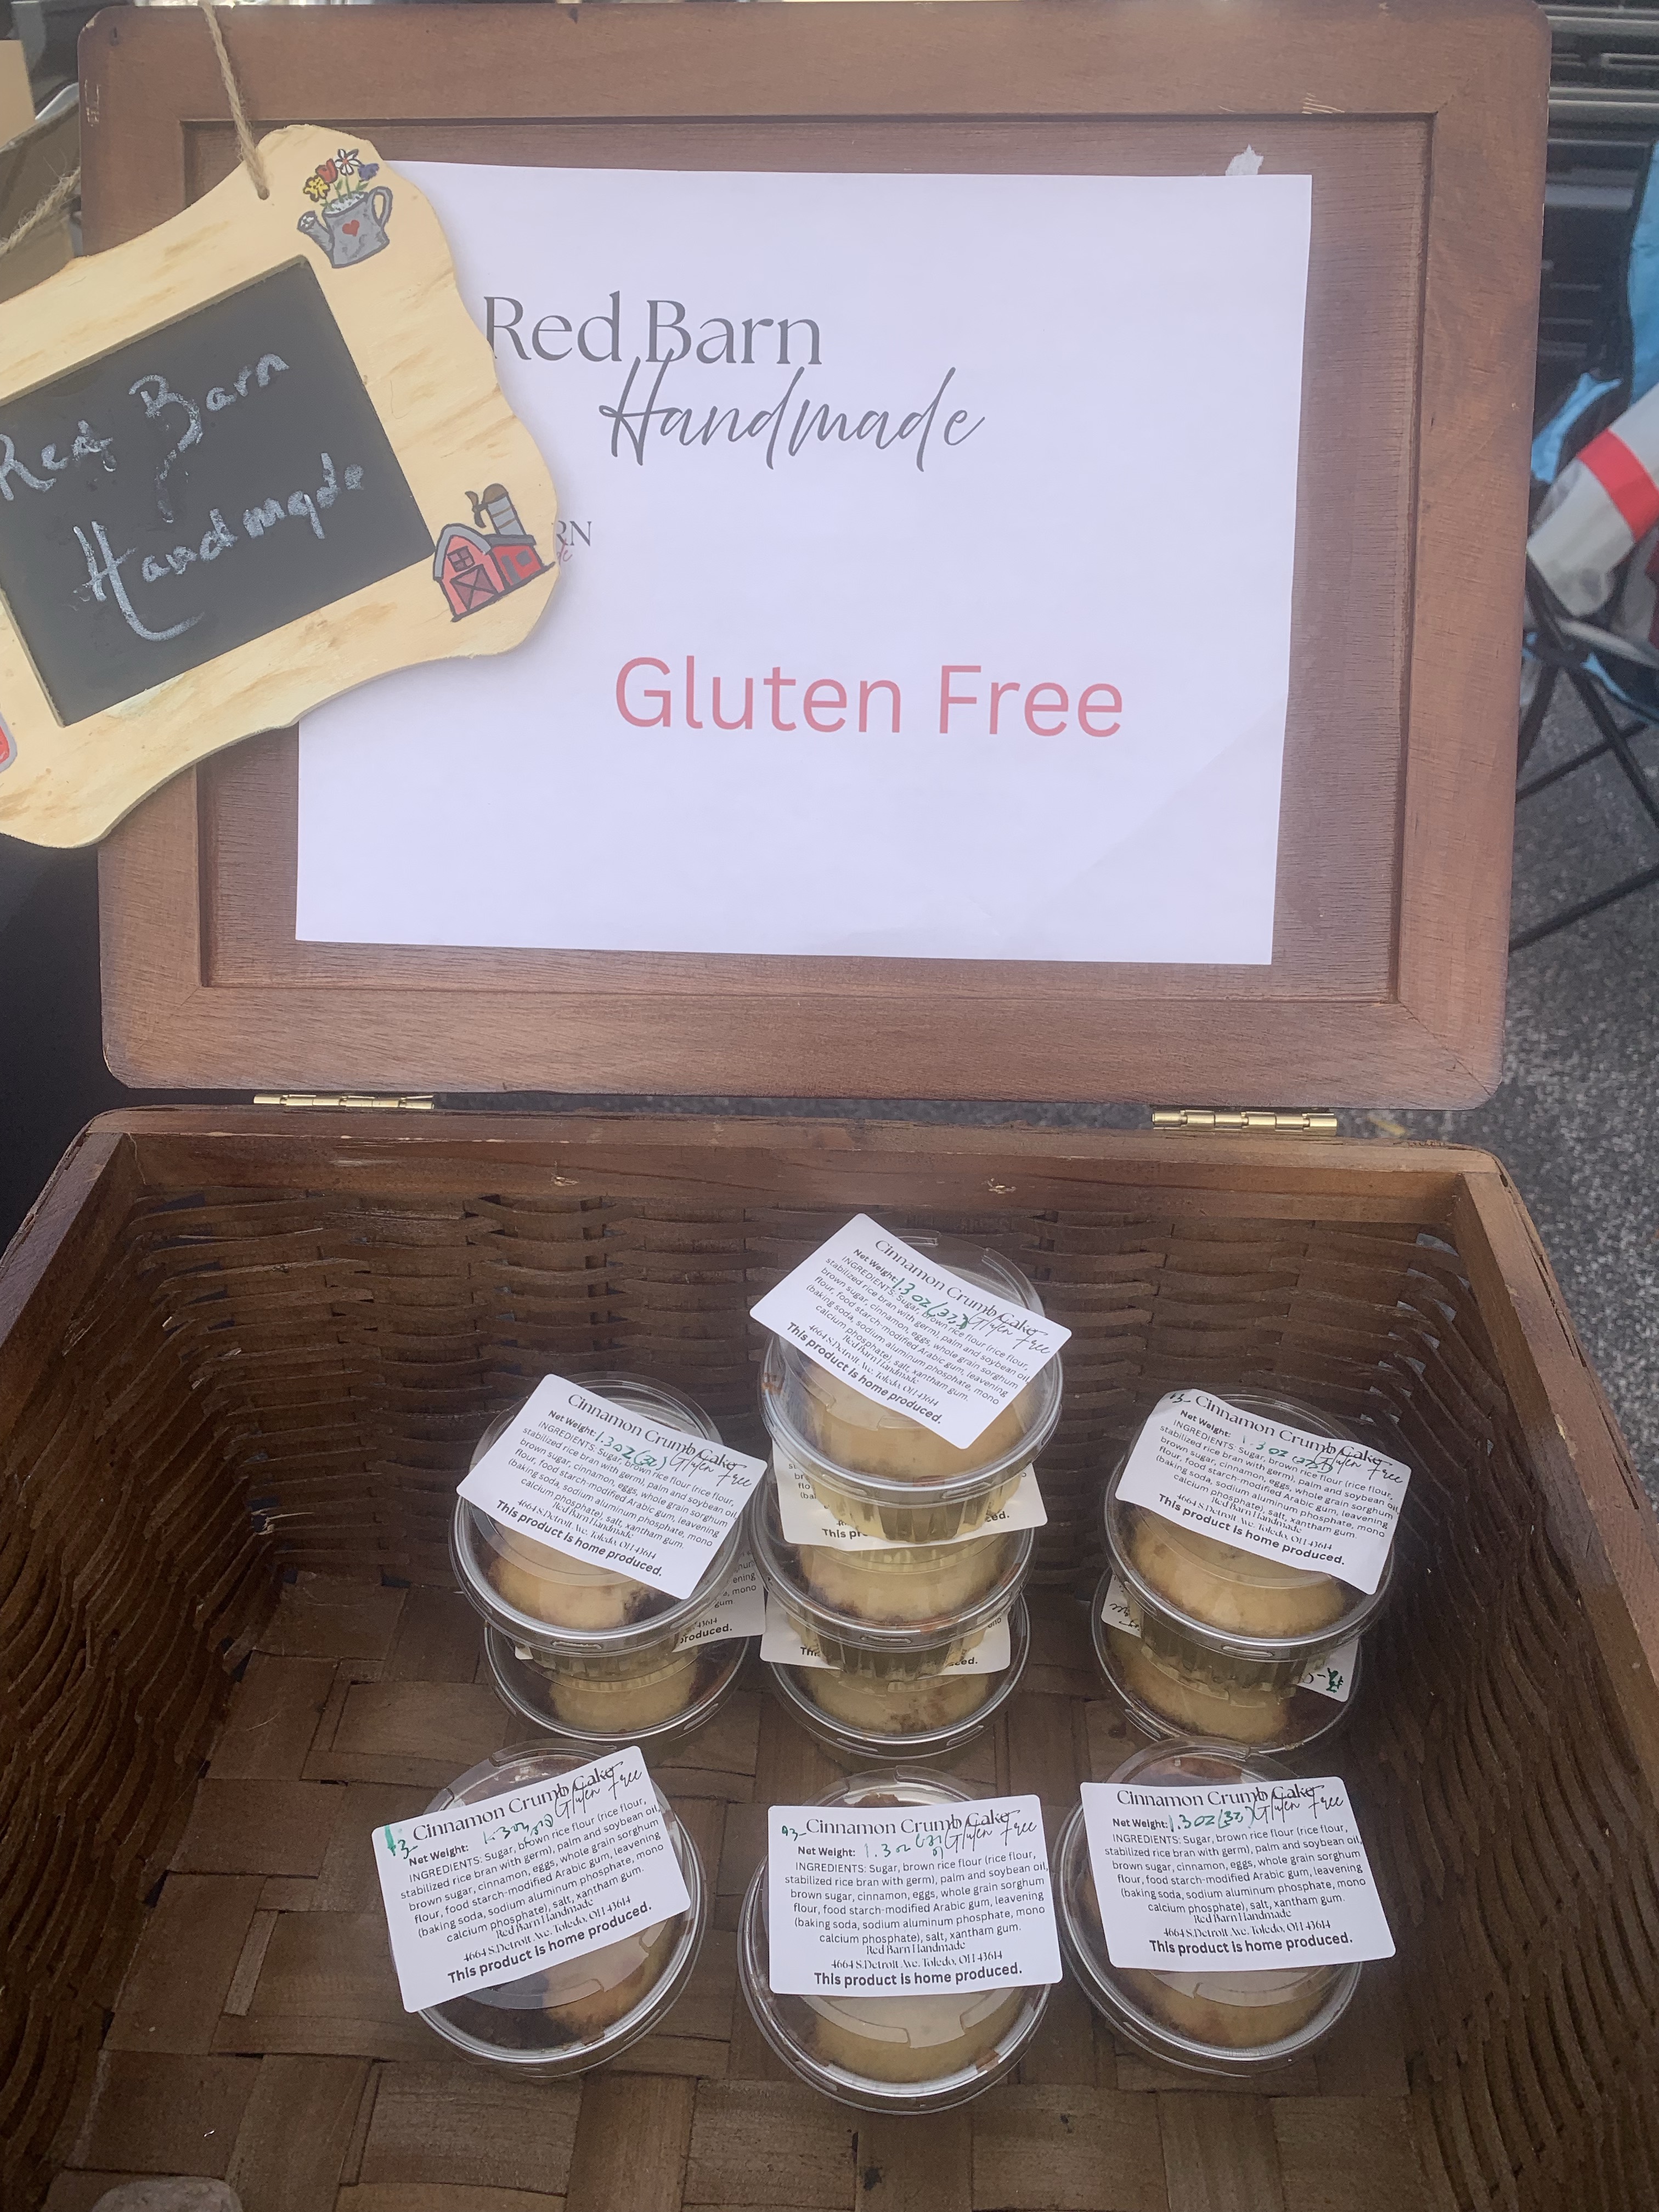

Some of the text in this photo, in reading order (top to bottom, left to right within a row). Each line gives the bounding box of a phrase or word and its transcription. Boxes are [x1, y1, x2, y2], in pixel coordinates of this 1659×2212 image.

[483, 291, 822, 365] Red Barn
[129, 353, 290, 472] Barn
[599, 348, 985, 472] Handmade
[73, 453, 365, 641] Handmade
[616, 655, 1123, 738] Gluten Free
[853, 1249, 899, 1283] Net Weight:
[875, 1240, 945, 1291] Cinnamon
[946, 1287, 997, 1317] Crumb
[995, 1312, 1039, 1337] Cake
[787, 1322, 943, 1424] This product is home produced.
[548, 1410, 597, 1437] Net Weight:
[568, 1394, 642, 1436] Cinnamon
[644, 1430, 696, 1455] Crumb
[695, 1448, 739, 1472] Cake
[1180, 1409, 1232, 1438] Net Weight:
[1195, 1396, 1275, 1436] Cinnamon
[1279, 1430, 1337, 1454] Crumb
[1338, 1446, 1384, 1467] Cake
[496, 1499, 662, 1577] This product is home produced.
[822, 1528, 846, 1538] This
[1159, 1493, 1345, 1565] This product is home produced.
[732, 1573, 756, 1583] ening
[732, 1585, 757, 1595] mono
[413, 1807, 505, 1841] Cinnamon
[509, 1784, 569, 1813] Crumb
[572, 1765, 615, 1793] Cake
[1116, 1785, 1316, 1807] Cinnamon Crumb Cake
[805, 1819, 896, 1835] Cinnamon
[900, 1814, 962, 1833] Crumb
[965, 1810, 1011, 1829] Cake
[1112, 1818, 1168, 1831] Net Weight:
[409, 1844, 469, 1867] Net Weight:
[795, 1851, 1036, 1875] INGREDIENTS: Sugar, brown rice flour (rice flour,
[798, 1846, 856, 1859] Net Weight:
[785, 1860, 1050, 1887] stabilized rice bran with germ), palm and soybean oil,
[791, 1877, 1045, 1903] brown sugar, cinnamon, eggs, whole grain sorghum
[793, 1891, 1045, 1915] flour, food starch-modified Arabic gum, leavening
[794, 1906, 1045, 1931] (baking soda, sodium aluminum phosphate, mono
[447, 1900, 652, 1984] This product is home produced.
[819, 1923, 1022, 1946] calcium phosphate), salt, xantham gum.
[1149, 1931, 1353, 1957] This product is home produced.
[866, 1944, 884, 1955] Red
[887, 1944, 911, 1955] Barn
[814, 1961, 1023, 1989] This product is home produced.
